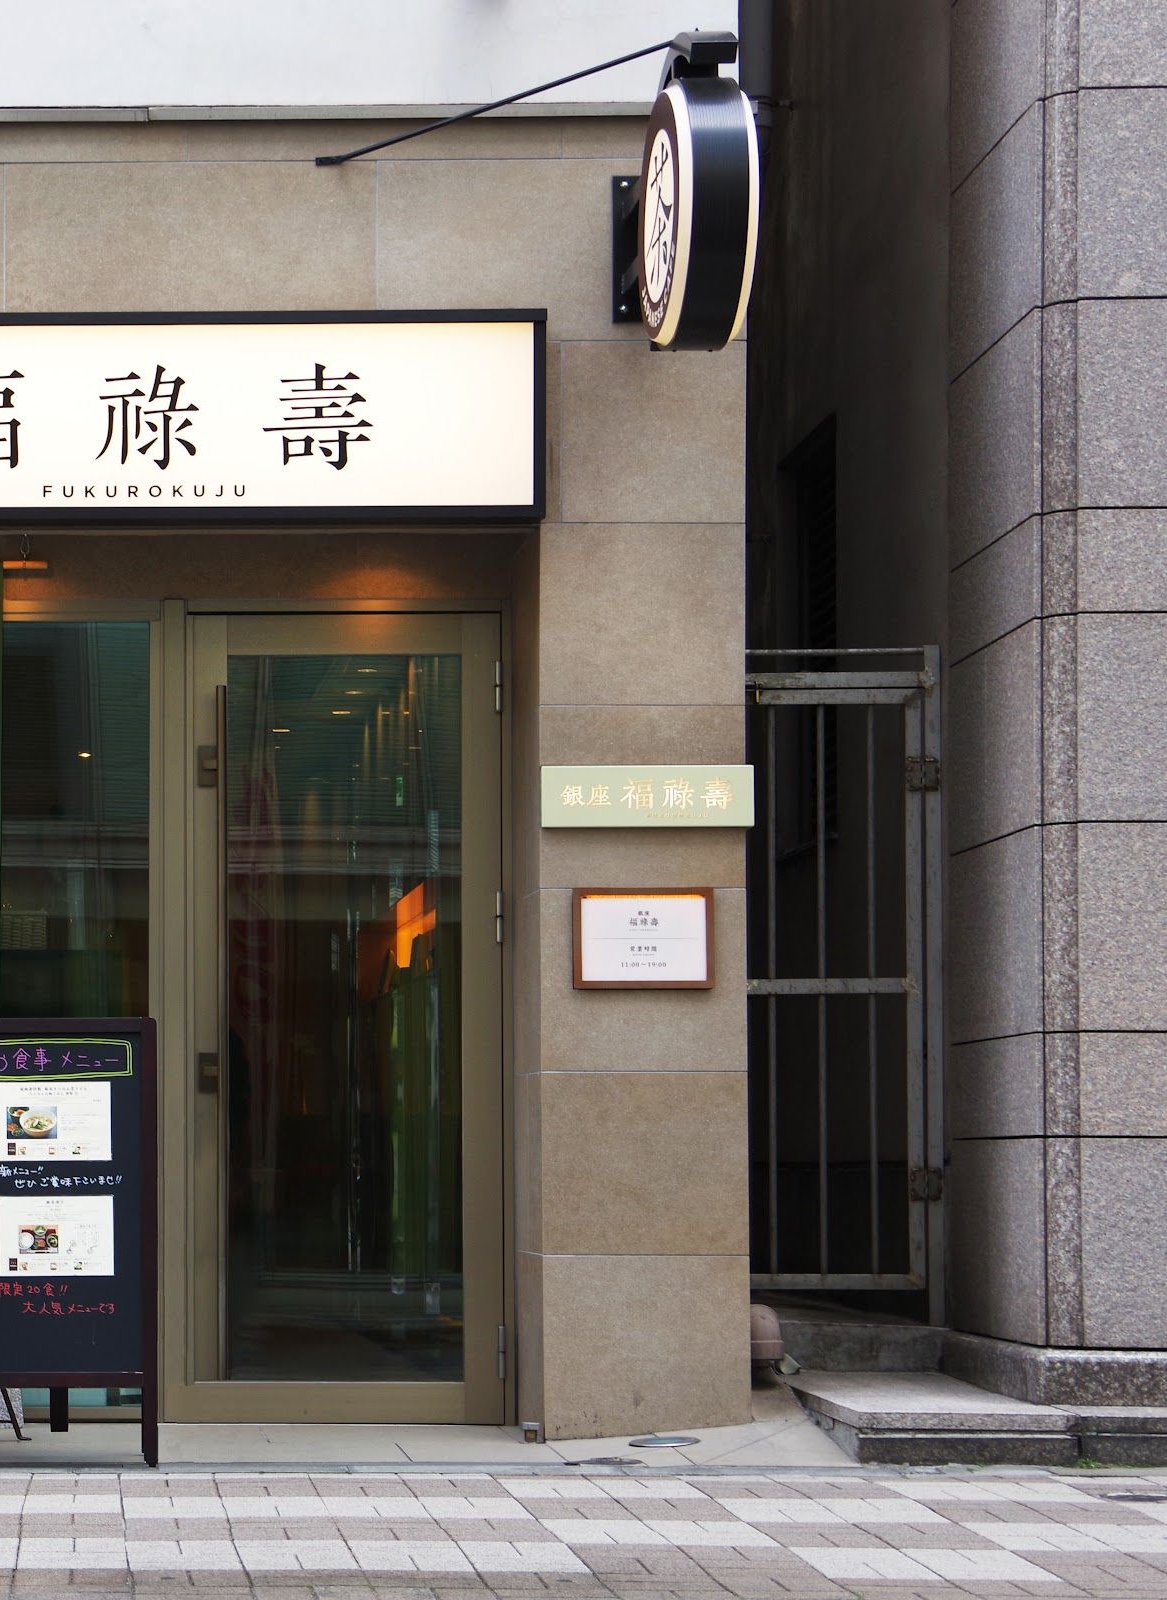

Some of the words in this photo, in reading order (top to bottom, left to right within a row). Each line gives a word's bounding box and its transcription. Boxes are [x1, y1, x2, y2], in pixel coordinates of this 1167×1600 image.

[42, 484, 246, 499] FUKUROKUJU
[560, 783, 611, 806] 銀座
[61, 1050, 121, 1068] メニュー
